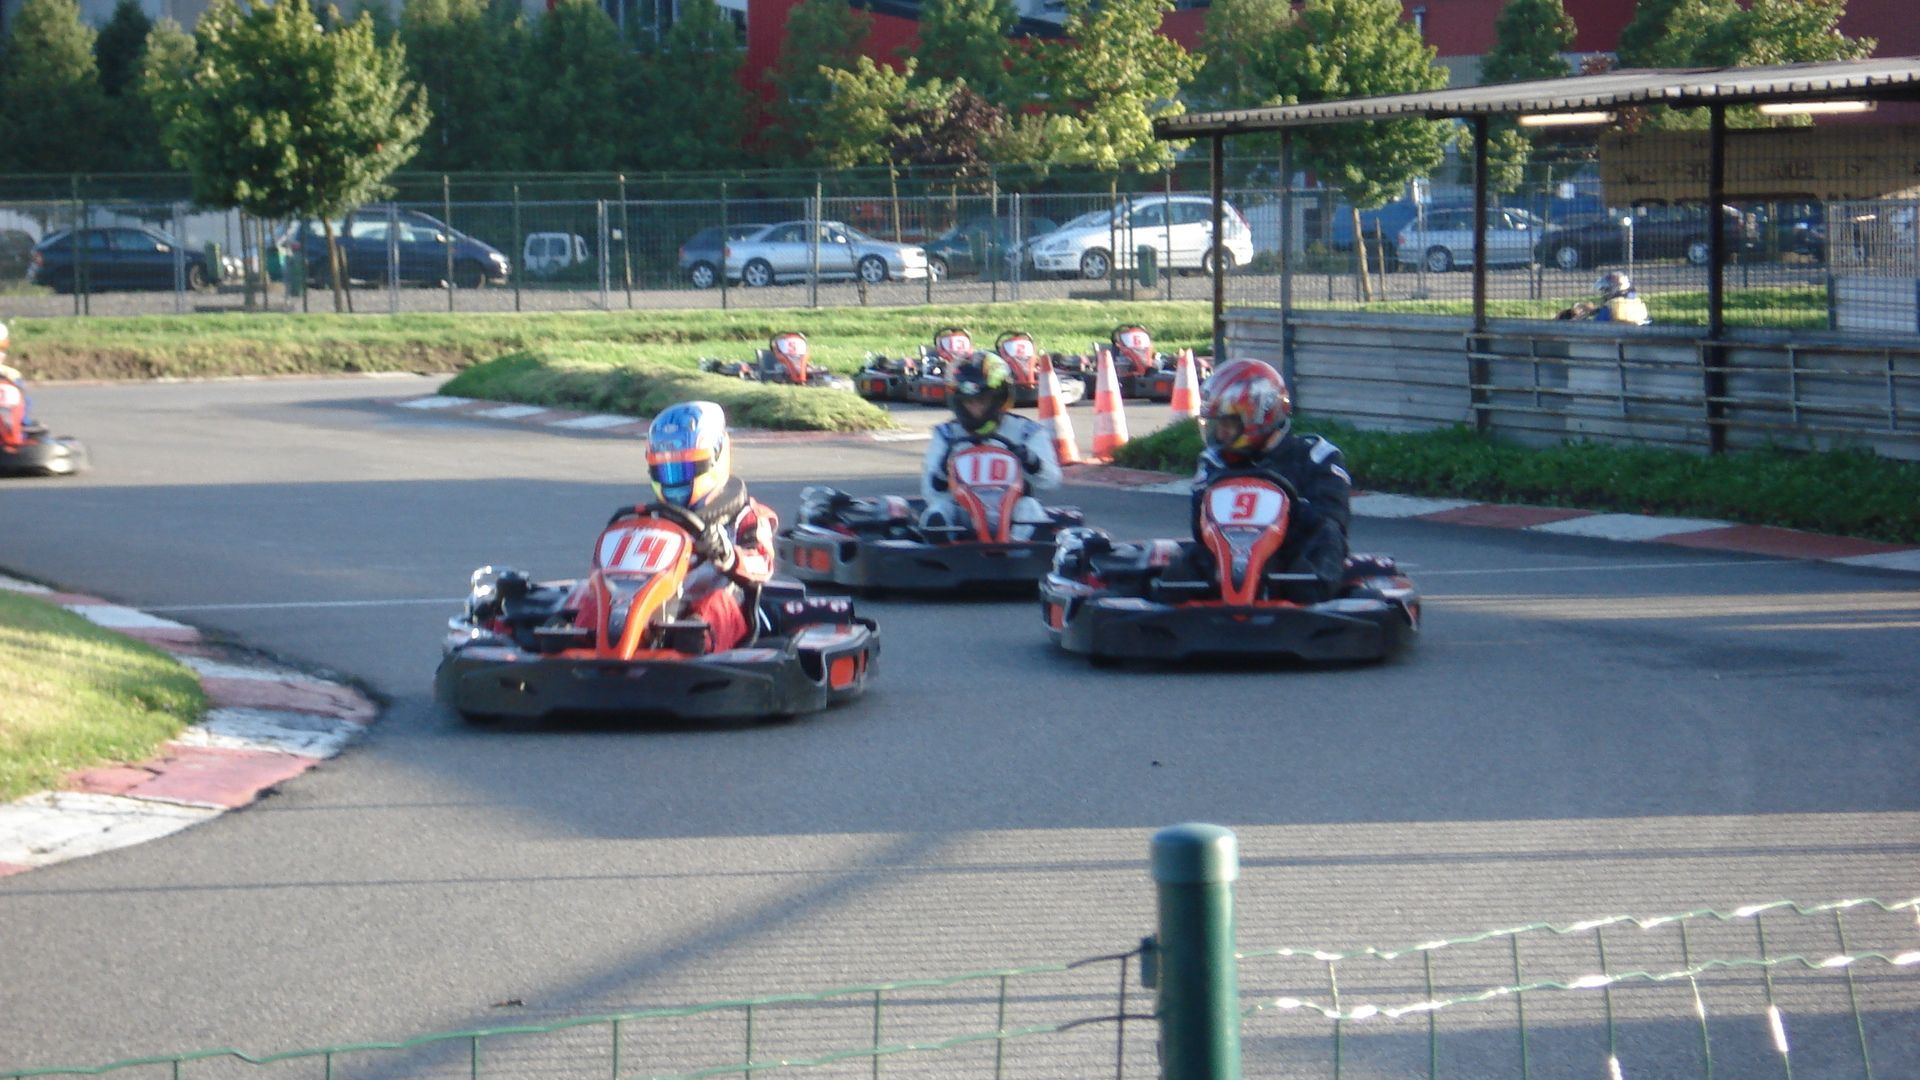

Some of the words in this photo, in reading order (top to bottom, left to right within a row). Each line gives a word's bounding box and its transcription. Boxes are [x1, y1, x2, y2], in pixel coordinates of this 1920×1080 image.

[970, 457, 1008, 481] 10
[1232, 492, 1258, 519] 9
[608, 534, 669, 568] 14
